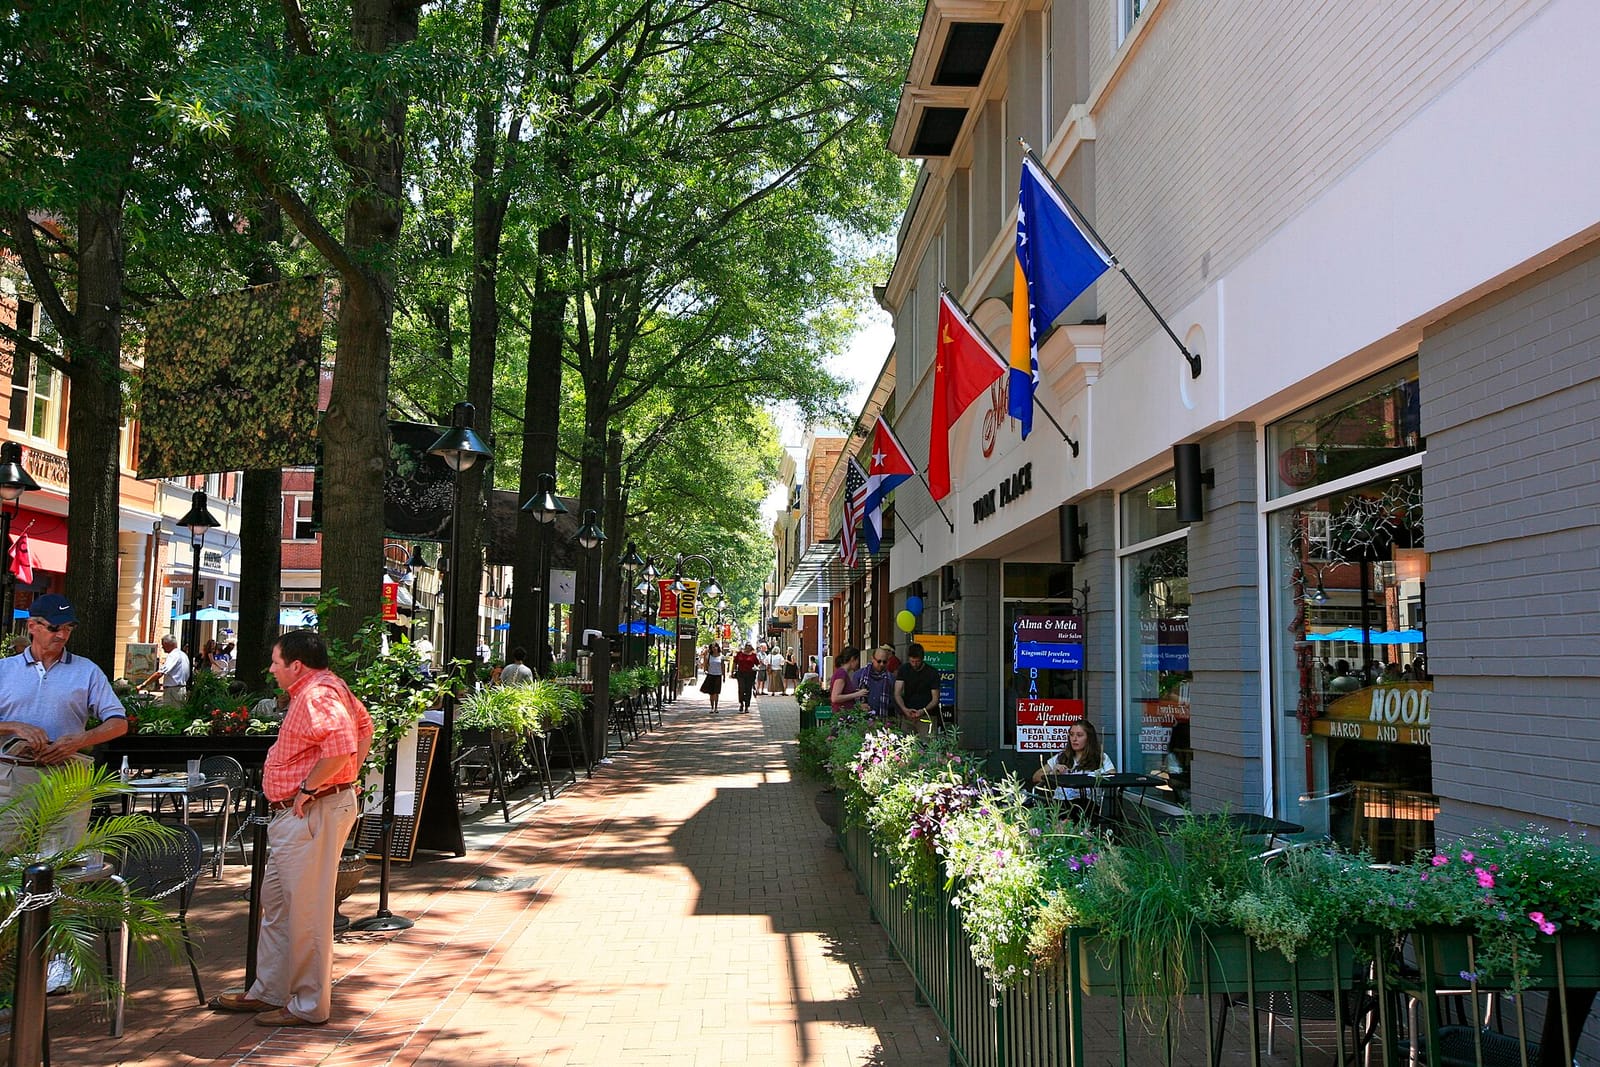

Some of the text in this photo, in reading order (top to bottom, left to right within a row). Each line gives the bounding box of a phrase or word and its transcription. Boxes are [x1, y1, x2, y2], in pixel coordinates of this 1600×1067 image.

[999, 462, 1032, 508] PLACE
[1018, 619, 1077, 630] Alma & Mela
[1047, 650, 1071, 658] Jewelers
[1018, 702, 1054, 712] E. Tailor
[1035, 713, 1083, 722] Alterations
[1329, 721, 1361, 739] MARCO
[1376, 726, 1398, 742] AND
